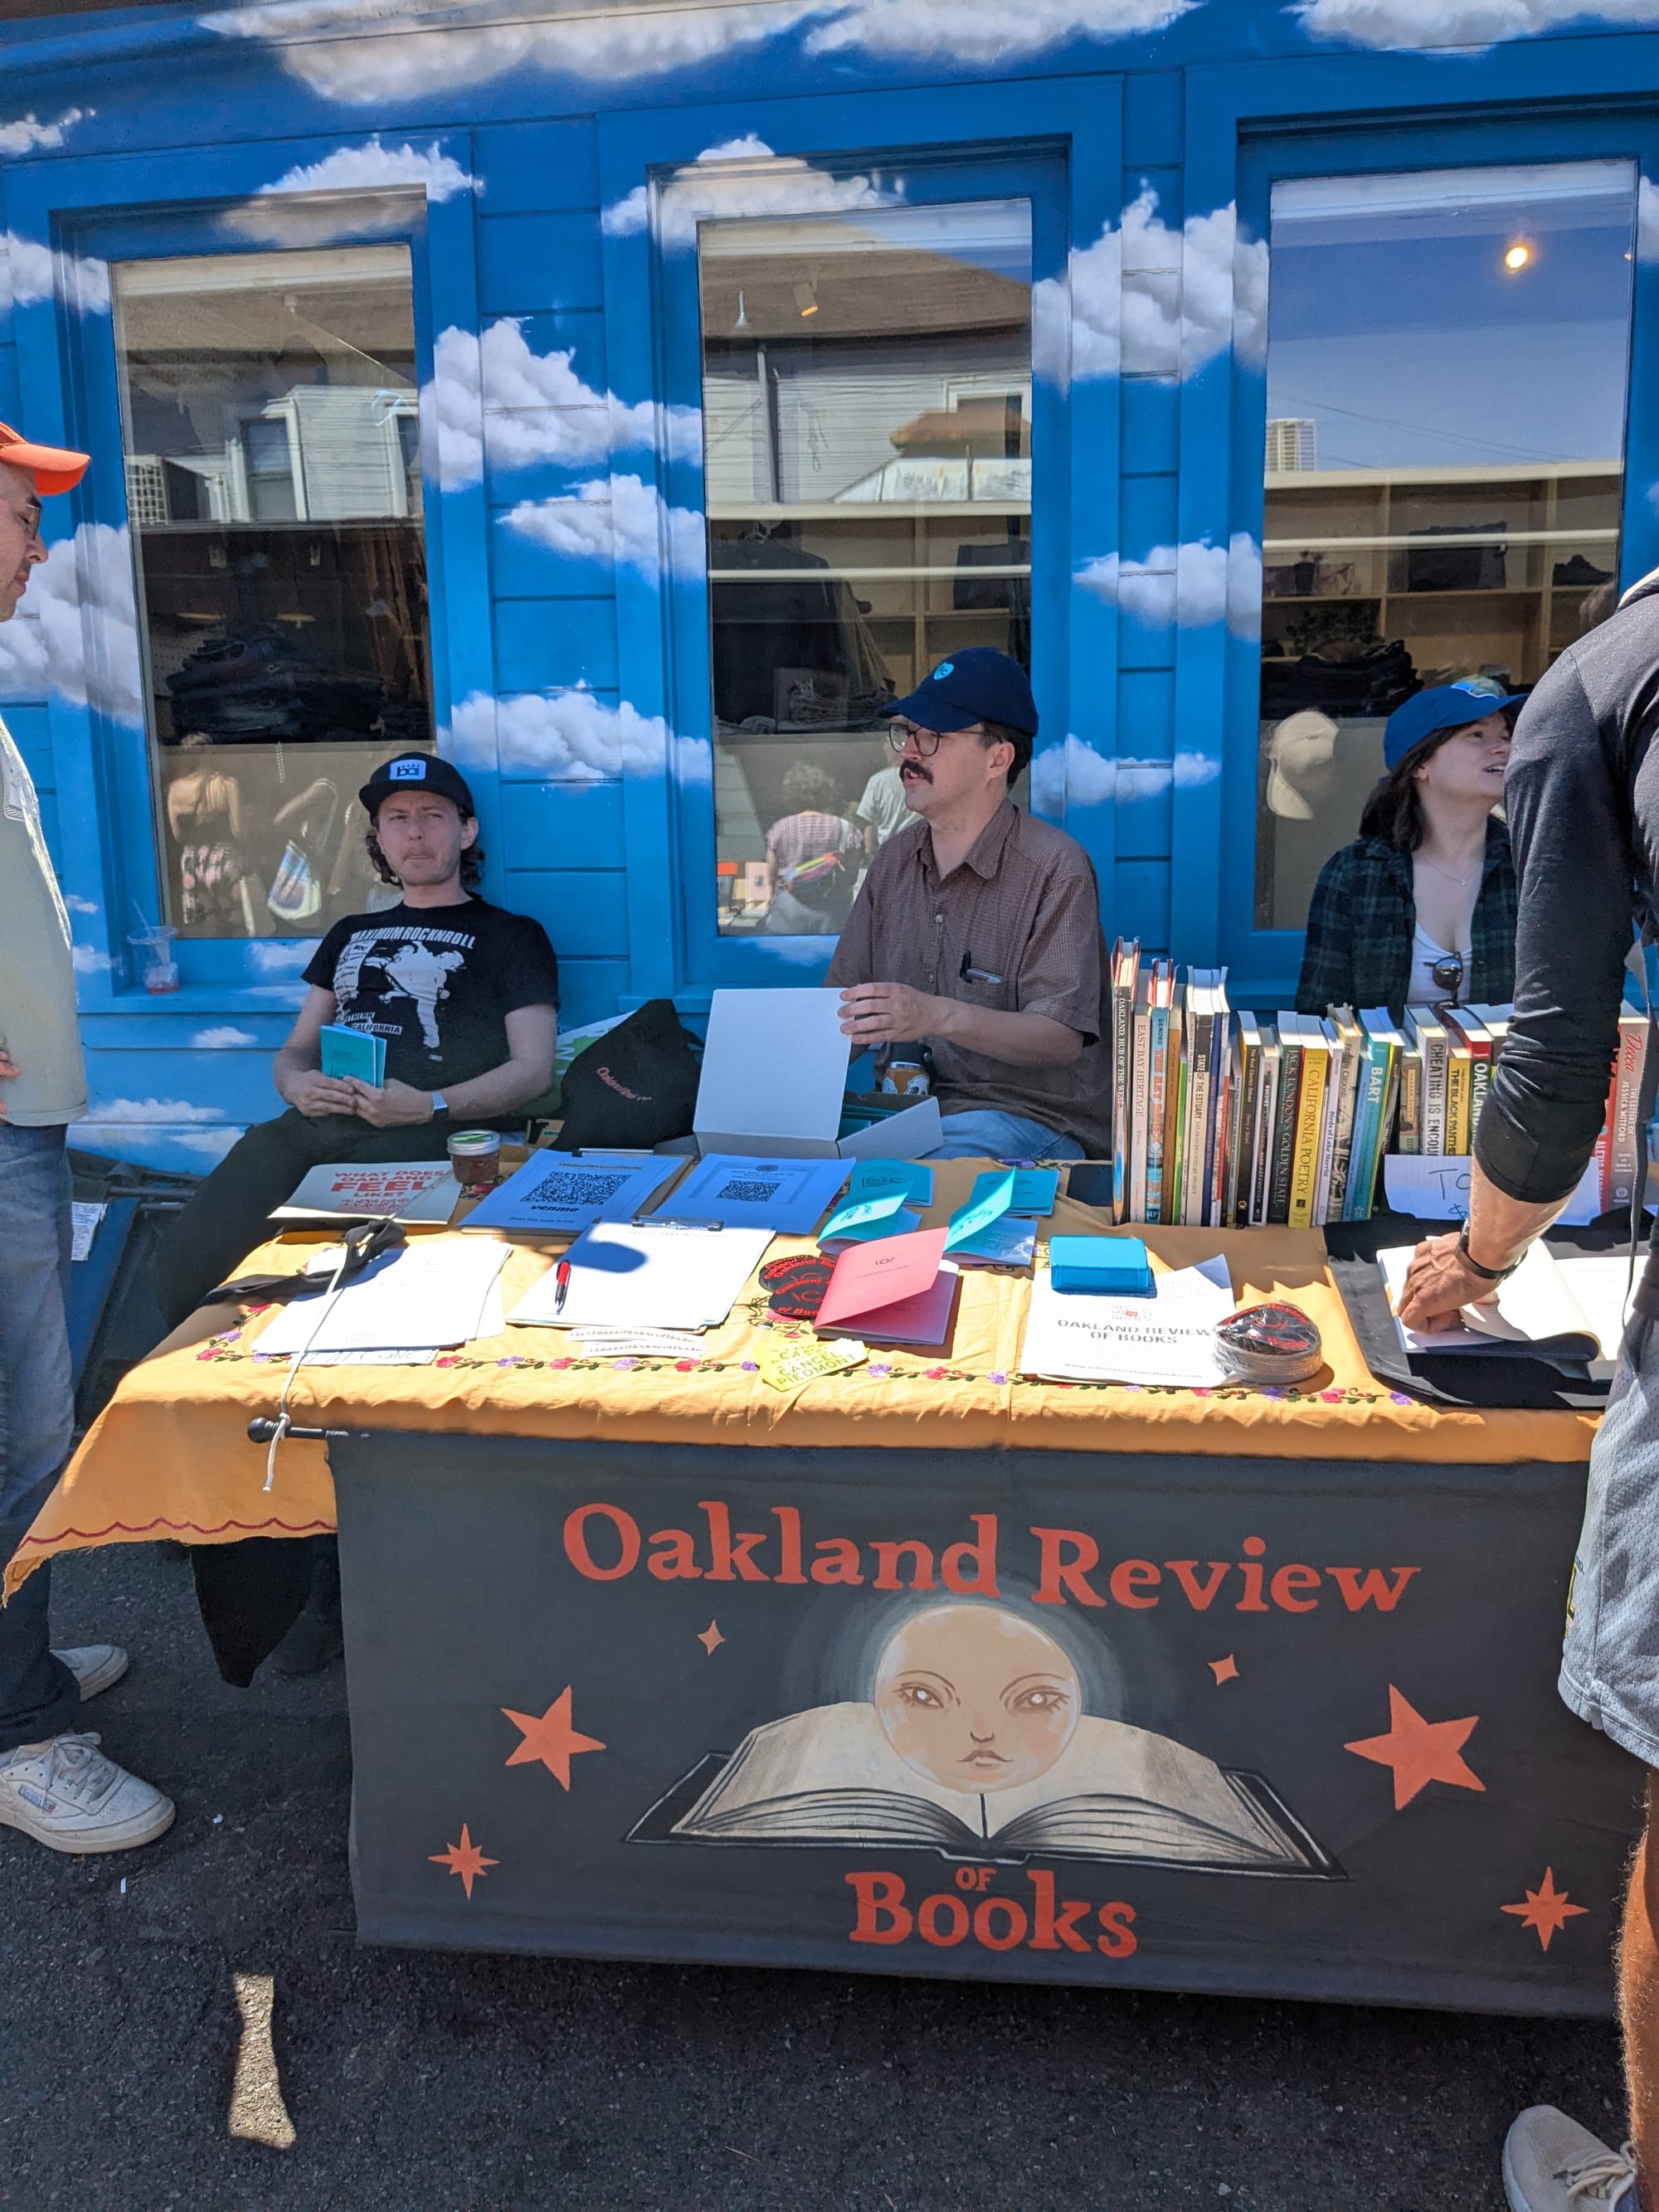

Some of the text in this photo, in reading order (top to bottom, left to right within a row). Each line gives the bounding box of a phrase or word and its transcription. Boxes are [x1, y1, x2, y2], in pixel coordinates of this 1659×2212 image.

[352, 1023, 401, 1034] CALIFORNIA
[1118, 1056, 1124, 1067] OF
[1155, 1048, 1164, 1072] THE
[1197, 1054, 1206, 1072] STATE
[1288, 1050, 1301, 1075] JACK
[1625, 1033, 1642, 1072] Decca
[1135, 1024, 1146, 1117] EAST BAY HERITAGE
[1428, 1043, 1443, 1098] CHEATING
[1452, 1068, 1460, 1087] THE
[1154, 1076, 1163, 1099] KEY
[1195, 1082, 1204, 1093] THE
[1367, 1067, 1384, 1104] BART
[1472, 1063, 1488, 1125] OAKLAND
[1621, 1080, 1629, 1108] JESSICA
[1283, 1077, 1297, 1130] LONDON'S
[1302, 1070, 1320, 1145] CALIFORNIA
[1428, 1104, 1442, 1115] IS
[1449, 1088, 1458, 1119] BLACK
[1627, 1088, 1637, 1135] THE LETTERS OF
[1618, 1111, 1627, 1143] MITFORD
[1279, 1133, 1291, 1175] GOLDEN
[1297, 1148, 1312, 1194] POETRY
[331, 1181, 434, 1192] FEEL
[1277, 1177, 1287, 1205] STATE
[775, 1277, 823, 1295] Oakland
[793, 1307, 820, 1315] Boo
[1057, 1319, 1210, 1337] OAKLAND REVIEW
[1091, 1331, 1178, 1344] OF BOOKS
[776, 1353, 856, 1385] PIEDMONT
[779, 1352, 842, 1376] CANCEL
[563, 1500, 1422, 1613] Oakland Review
[955, 1867, 996, 1892] OF
[844, 1869, 1138, 1958] Books
